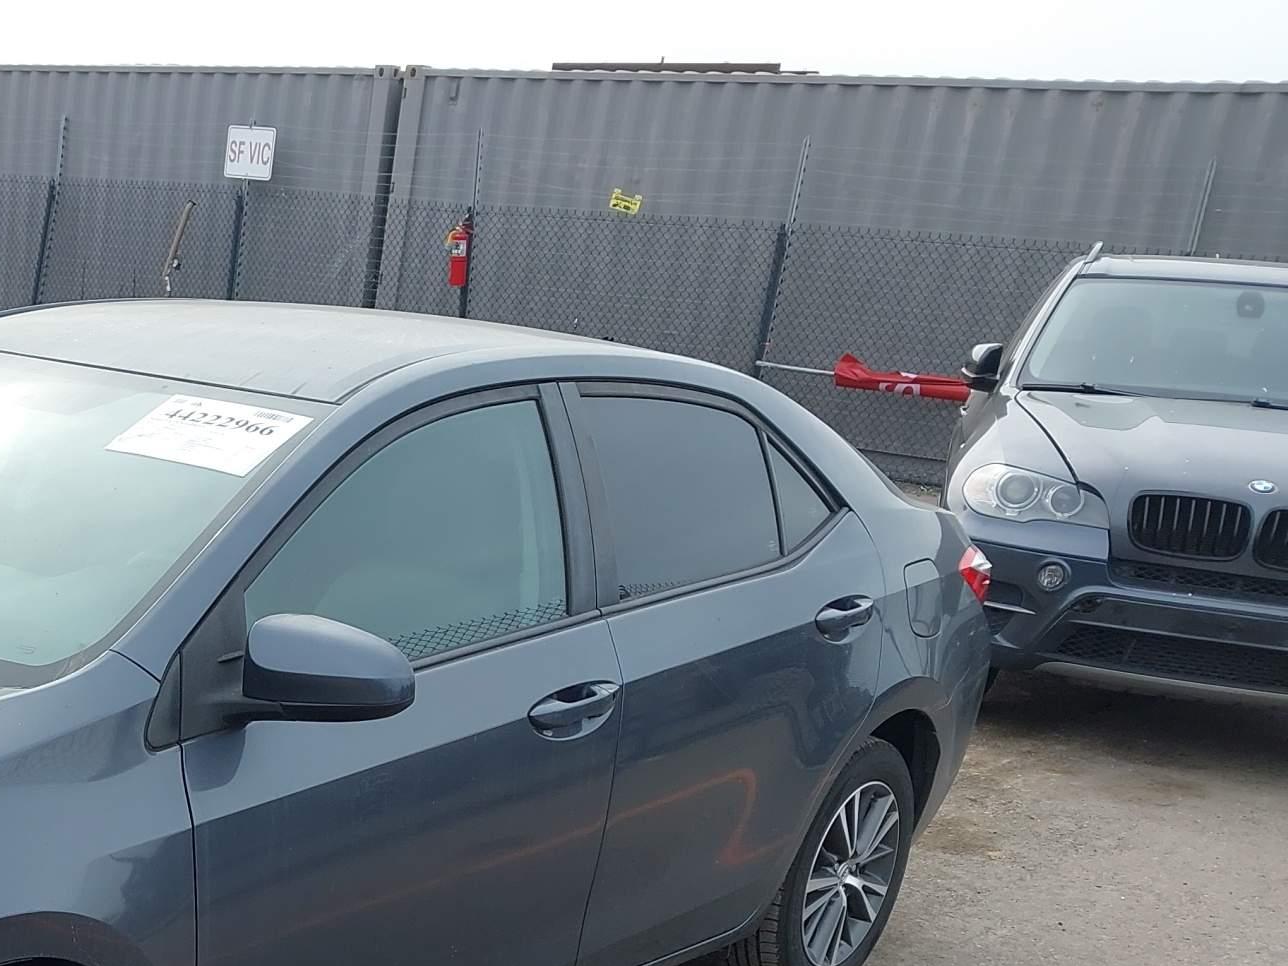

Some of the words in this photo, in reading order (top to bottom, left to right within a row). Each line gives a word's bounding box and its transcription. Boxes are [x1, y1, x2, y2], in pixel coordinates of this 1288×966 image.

[229, 140, 246, 163] SF
[249, 141, 271, 166] VIC
[165, 408, 280, 436] 44222966
